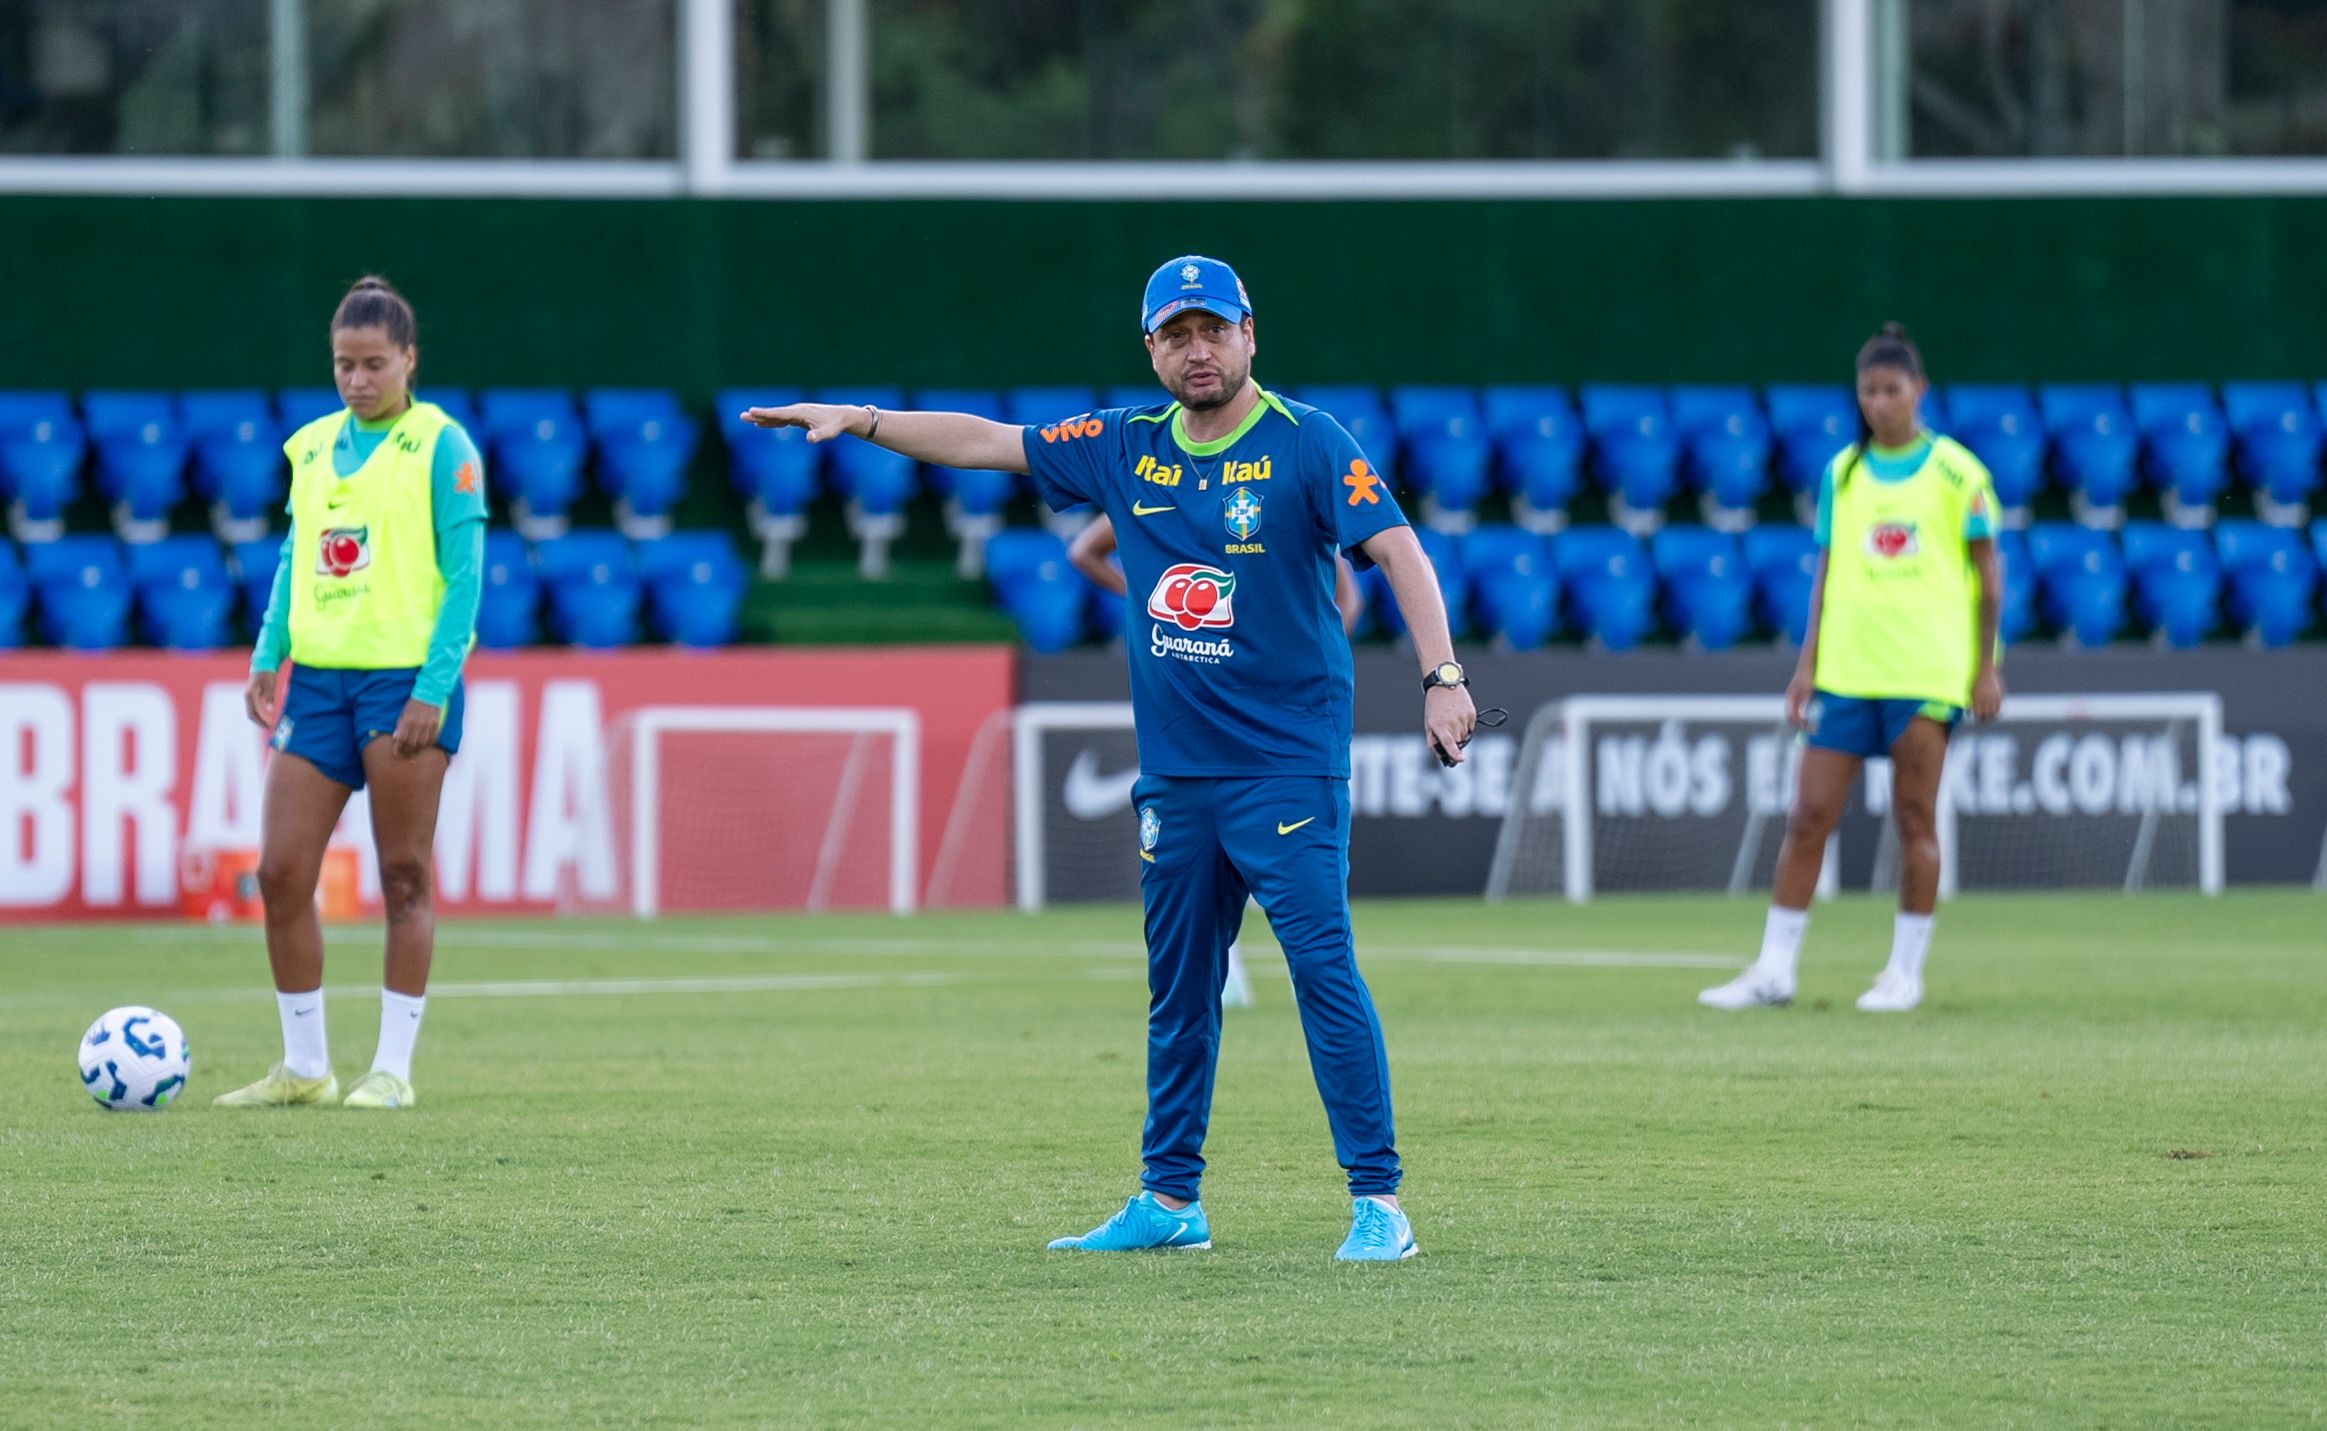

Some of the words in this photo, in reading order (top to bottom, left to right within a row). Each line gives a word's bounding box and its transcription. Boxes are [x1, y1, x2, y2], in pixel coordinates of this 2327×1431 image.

[1040, 419, 1104, 444] vivo
[1221, 454, 1272, 486] Itaú
[1224, 543, 1266, 554] BRASIL
[1150, 622, 1234, 657] Guaraná
[1597, 716, 1731, 817] NÓS
